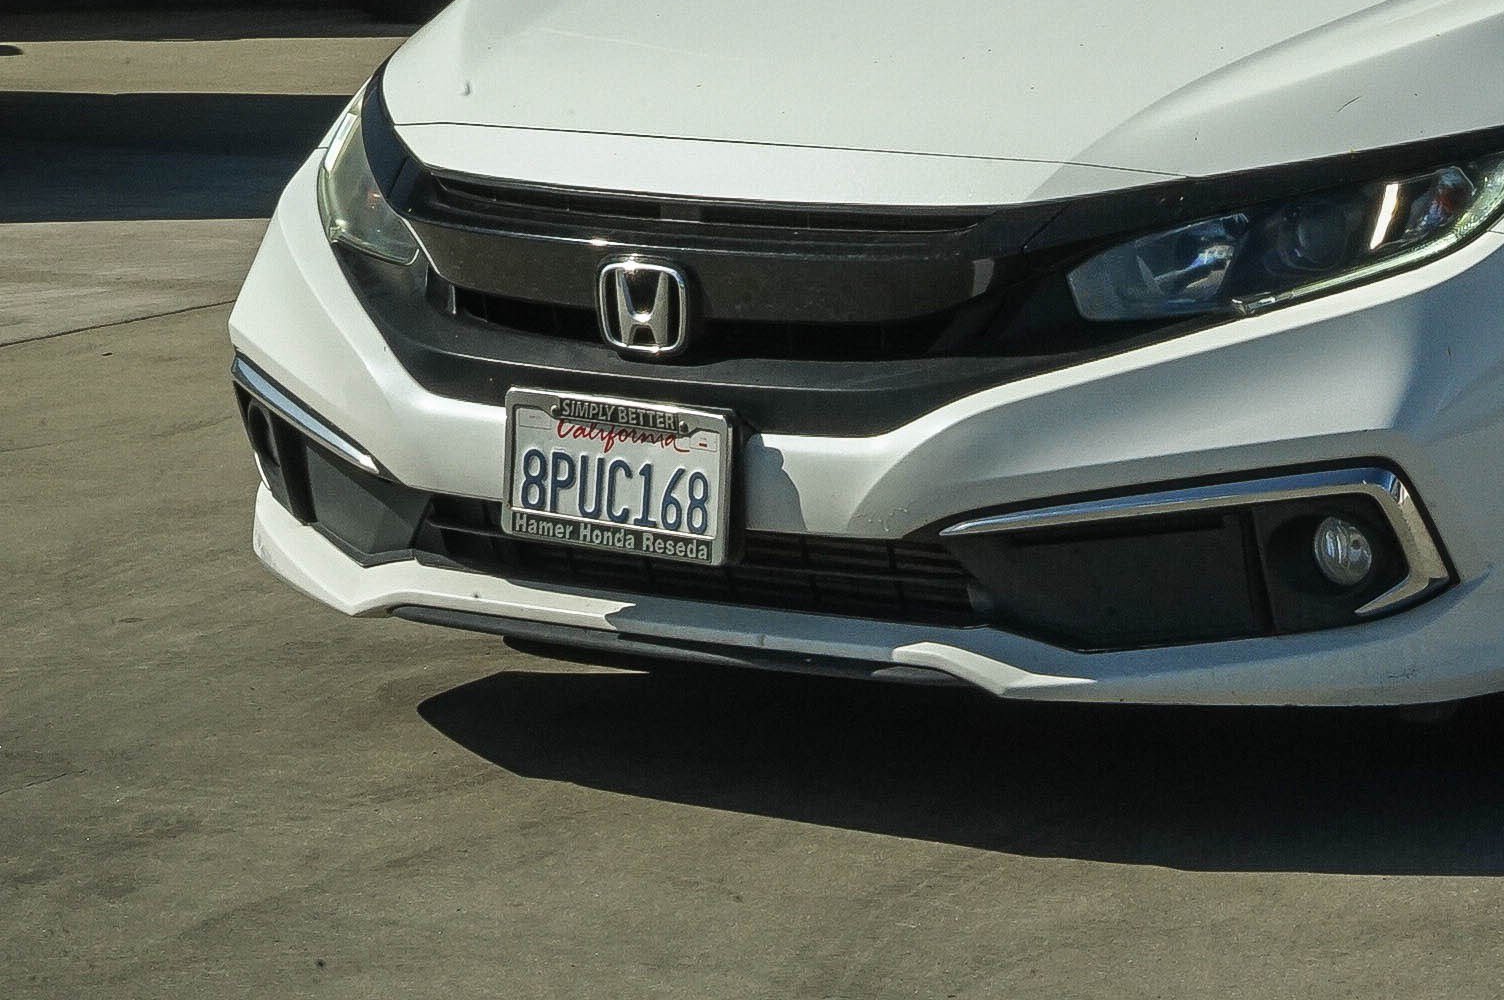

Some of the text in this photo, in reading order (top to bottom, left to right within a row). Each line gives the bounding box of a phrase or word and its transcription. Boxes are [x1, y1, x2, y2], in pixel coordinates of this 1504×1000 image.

[562, 399, 676, 429] SIMPLY BETTER
[557, 418, 690, 453] California
[520, 448, 709, 534] 8PUC168
[515, 512, 709, 561] Hamer Honda Reseda
